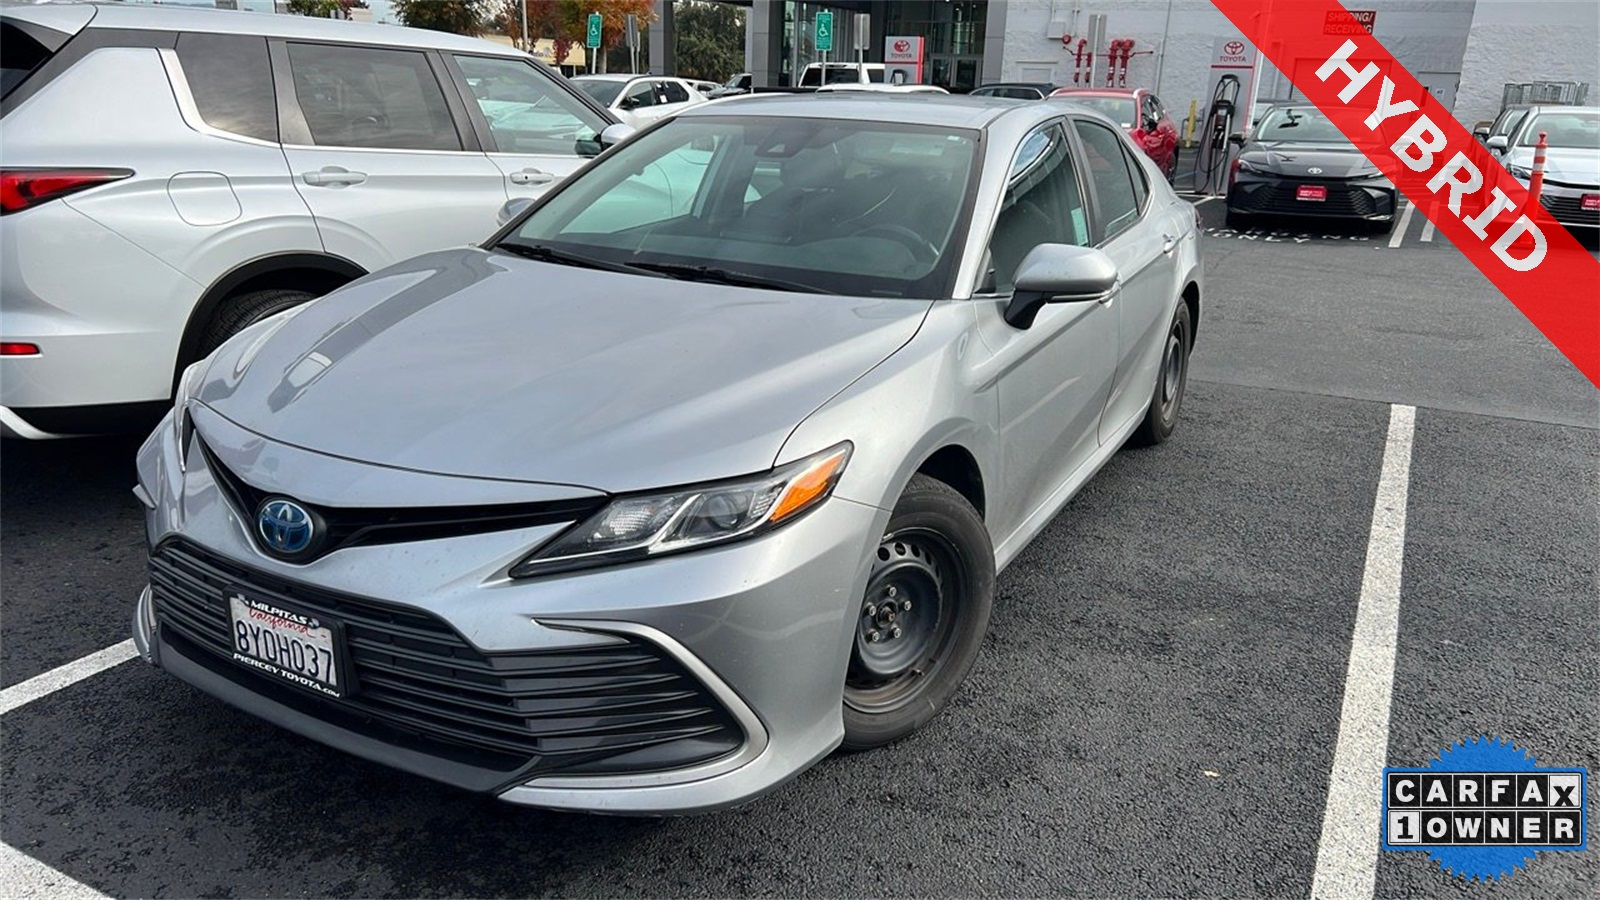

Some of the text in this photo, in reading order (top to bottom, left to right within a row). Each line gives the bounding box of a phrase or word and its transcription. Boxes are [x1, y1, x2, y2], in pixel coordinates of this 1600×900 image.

[1324, 24, 1372, 34] RECEIVING
[250, 599, 308, 625] MILPITAS
[233, 653, 280, 674] PIERCEY
